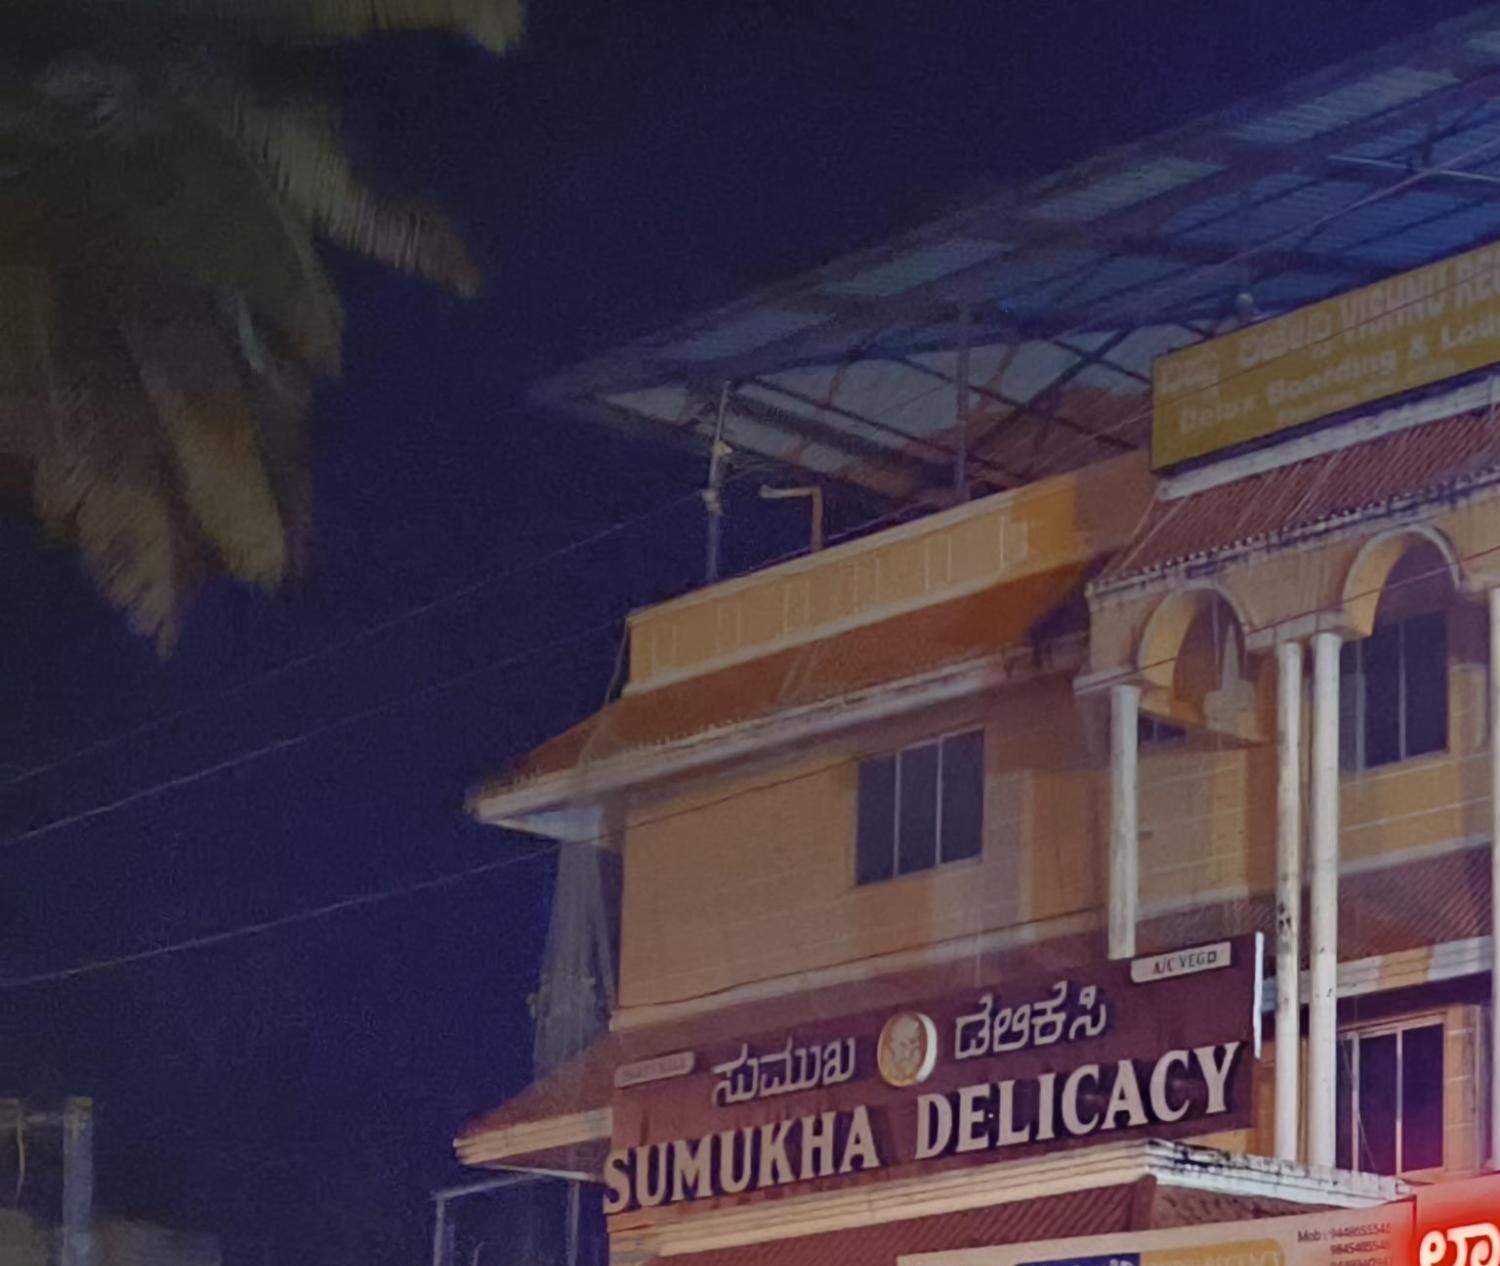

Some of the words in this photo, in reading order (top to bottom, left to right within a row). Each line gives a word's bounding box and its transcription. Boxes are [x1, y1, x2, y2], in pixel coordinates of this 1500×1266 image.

[1340, 262, 1448, 345] VISHNU
[1267, 349, 1396, 405] Boarding
[1408, 335, 1429, 361] &
[712, 1036, 856, 1105] ಸುಮುಖ
[955, 980, 1107, 1060] ಡೆಲಿಕೆಸಿ
[602, 1104, 880, 1214] SUMUKHA
[915, 1042, 1241, 1160] DELICACY
